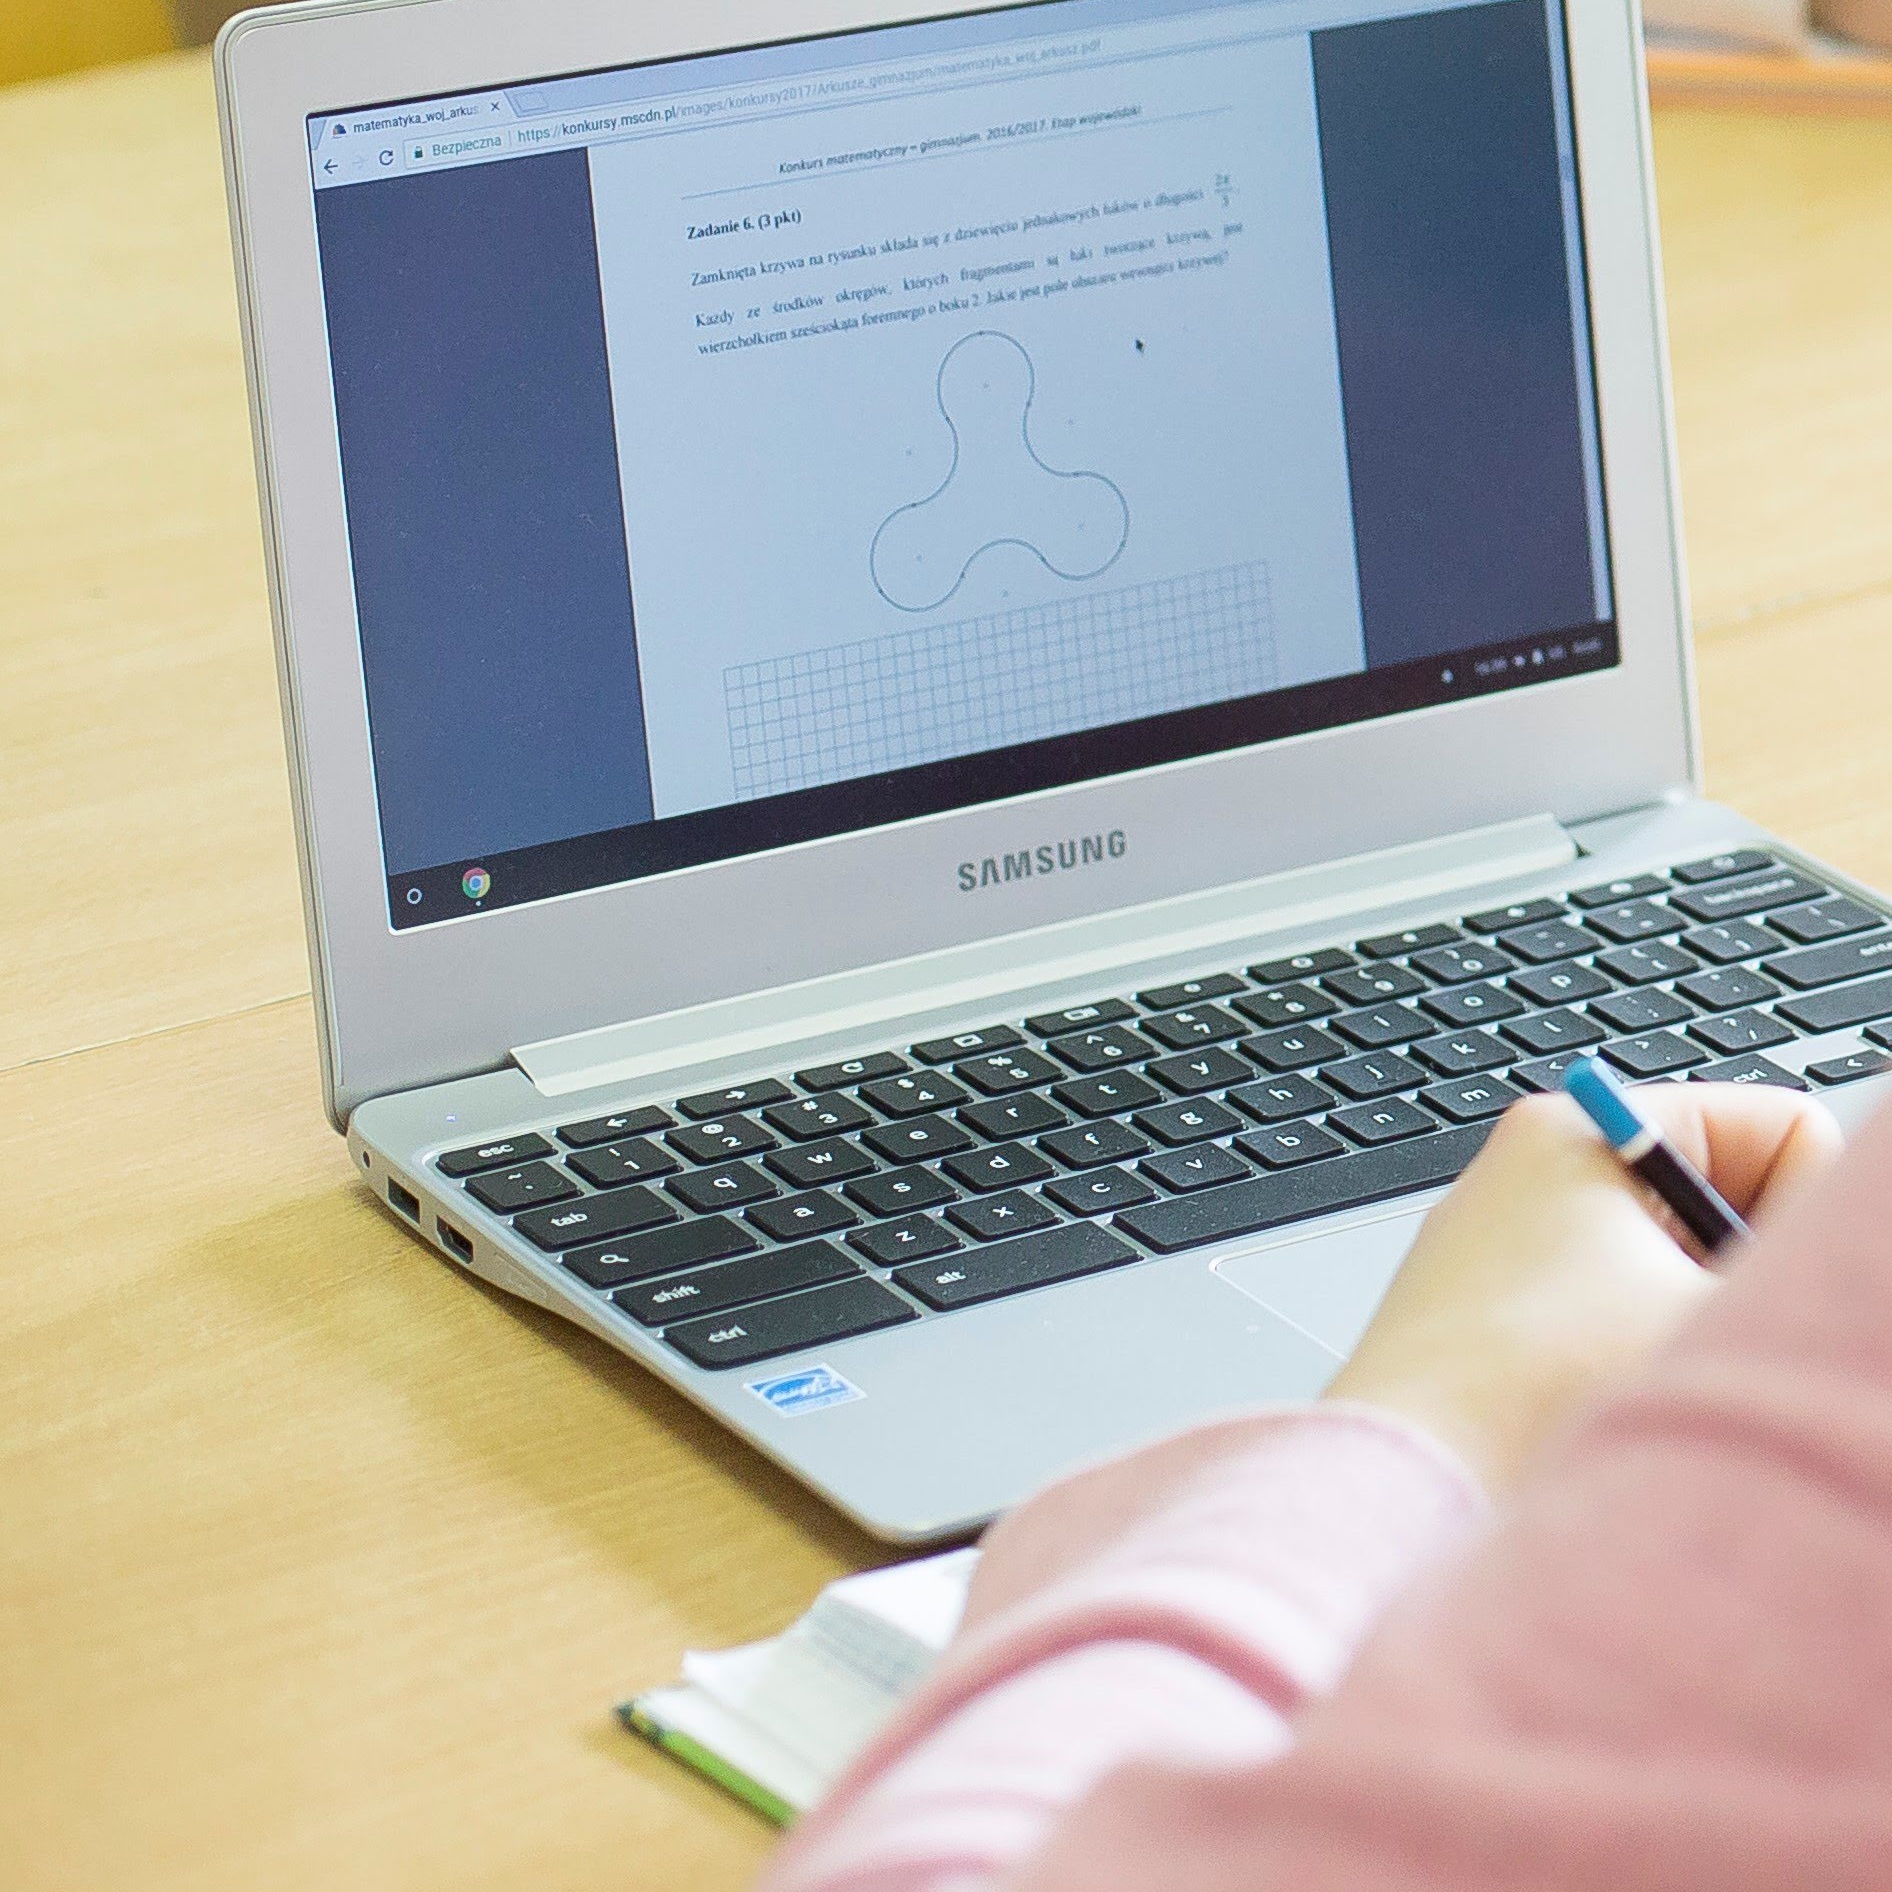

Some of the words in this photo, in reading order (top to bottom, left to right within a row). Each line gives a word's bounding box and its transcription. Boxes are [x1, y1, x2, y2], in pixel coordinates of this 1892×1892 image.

[432, 135, 502, 157] Bezpieczna
[687, 223, 740, 240] Zadanie
[743, 217, 755, 230] 6.
[758, 213, 771, 231] (3
[774, 208, 802, 228] pkt)
[691, 267, 757, 286] Zamknięta
[760, 257, 805, 274] krzywa
[809, 254, 824, 266] na
[939, 297, 970, 313] boku
[957, 829, 1127, 892] SAMSUNG
[1282, 1038, 1306, 1051] u
[1451, 1042, 1477, 1056] k
[1189, 1060, 1211, 1076] y
[1364, 1064, 1386, 1080] j
[917, 1090, 936, 1102] 4
[1097, 1084, 1119, 1096] t
[1267, 1088, 1295, 1101] h
[1460, 1087, 1492, 1103] m
[818, 1113, 839, 1124] 3
[1005, 1107, 1020, 1119] r
[1372, 1112, 1396, 1125] n
[721, 1136, 743, 1148] 2
[908, 1129, 930, 1141] e
[1083, 1132, 1101, 1146] f
[1274, 1134, 1302, 1148] b
[477, 1143, 516, 1159] esc
[806, 1151, 834, 1165] w
[989, 1155, 1012, 1170] d
[1184, 1158, 1204, 1170] v
[712, 1176, 738, 1190] q
[892, 1181, 913, 1194] s
[1090, 1182, 1112, 1194] c
[792, 1206, 816, 1219] a
[991, 1205, 1016, 1219] x
[550, 1212, 589, 1228] tab
[895, 1230, 917, 1243] z
[934, 1270, 968, 1285] alt
[651, 1285, 702, 1304] shift
[707, 1323, 749, 1344] ctrl
